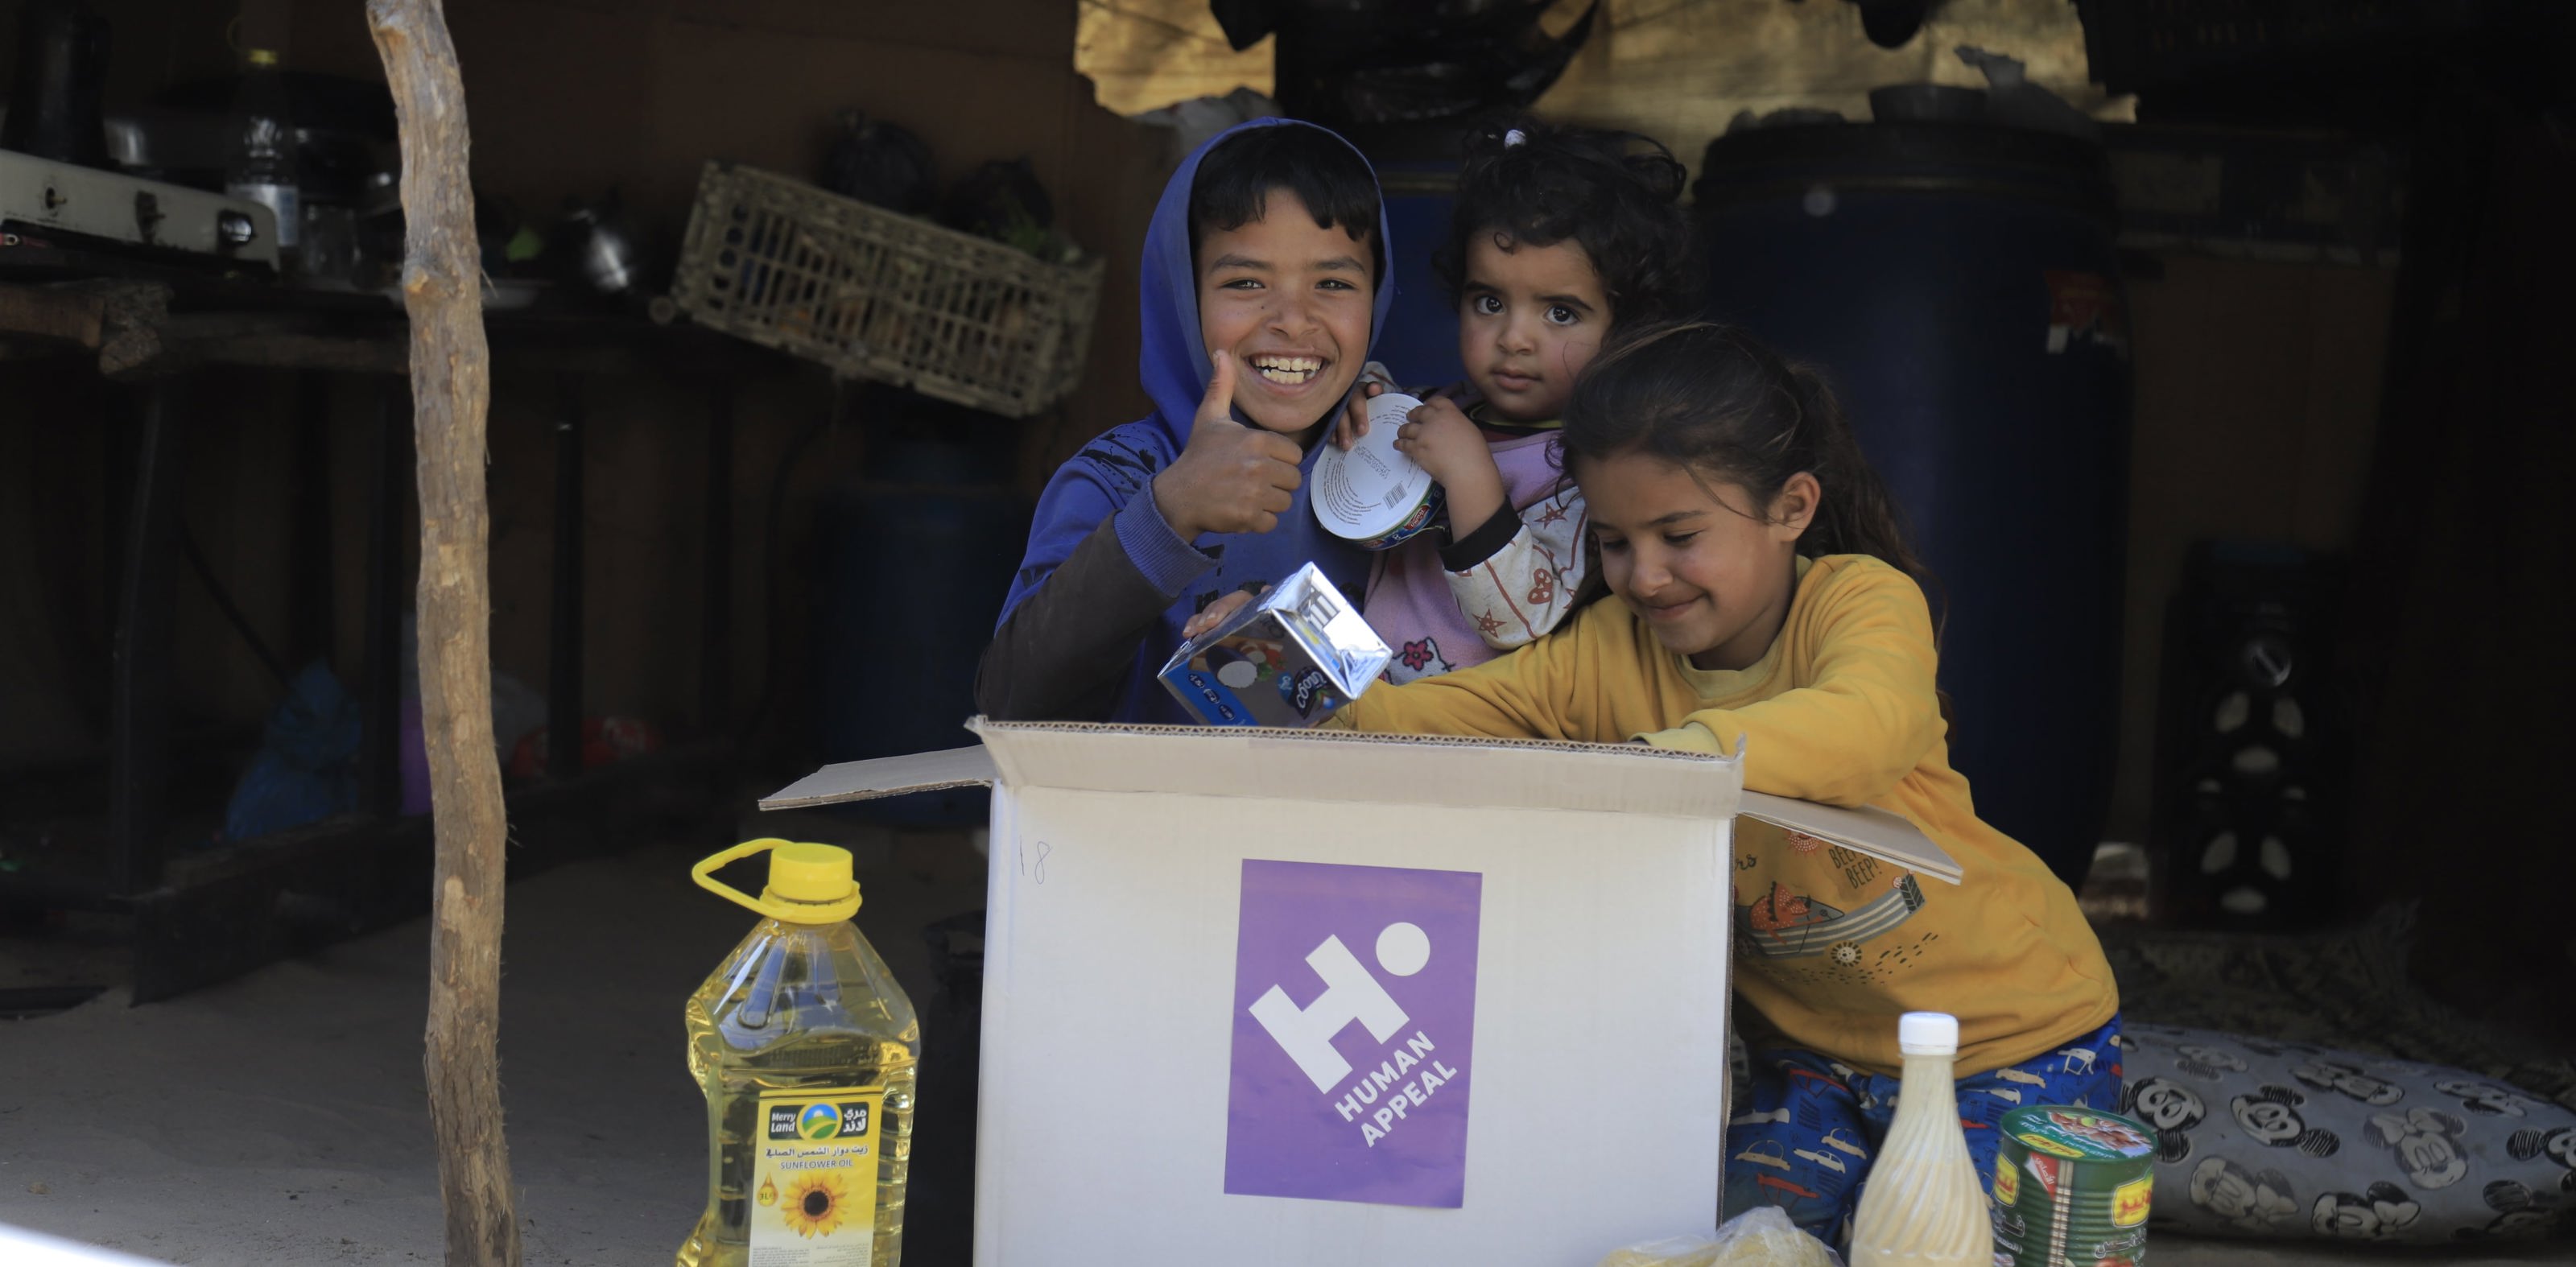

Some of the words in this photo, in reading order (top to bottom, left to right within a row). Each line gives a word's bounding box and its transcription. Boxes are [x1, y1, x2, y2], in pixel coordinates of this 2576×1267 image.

[1019, 835, 1053, 885] 18
[1845, 856, 1882, 889] BEEP!
[1334, 1030, 1435, 1122] HUMAN
[1360, 1060, 1458, 1148] APPEAL
[771, 1112, 796, 1123] Merry
[770, 1122, 796, 1133] Land
[843, 1118, 866, 1133] لاند
[797, 1147, 829, 1158] الشمس
[832, 1147, 849, 1158] دوار
[851, 1145, 869, 1154] زيت
[780, 1159, 836, 1170] SUNFLOWER
[838, 1158, 853, 1167] OIL
